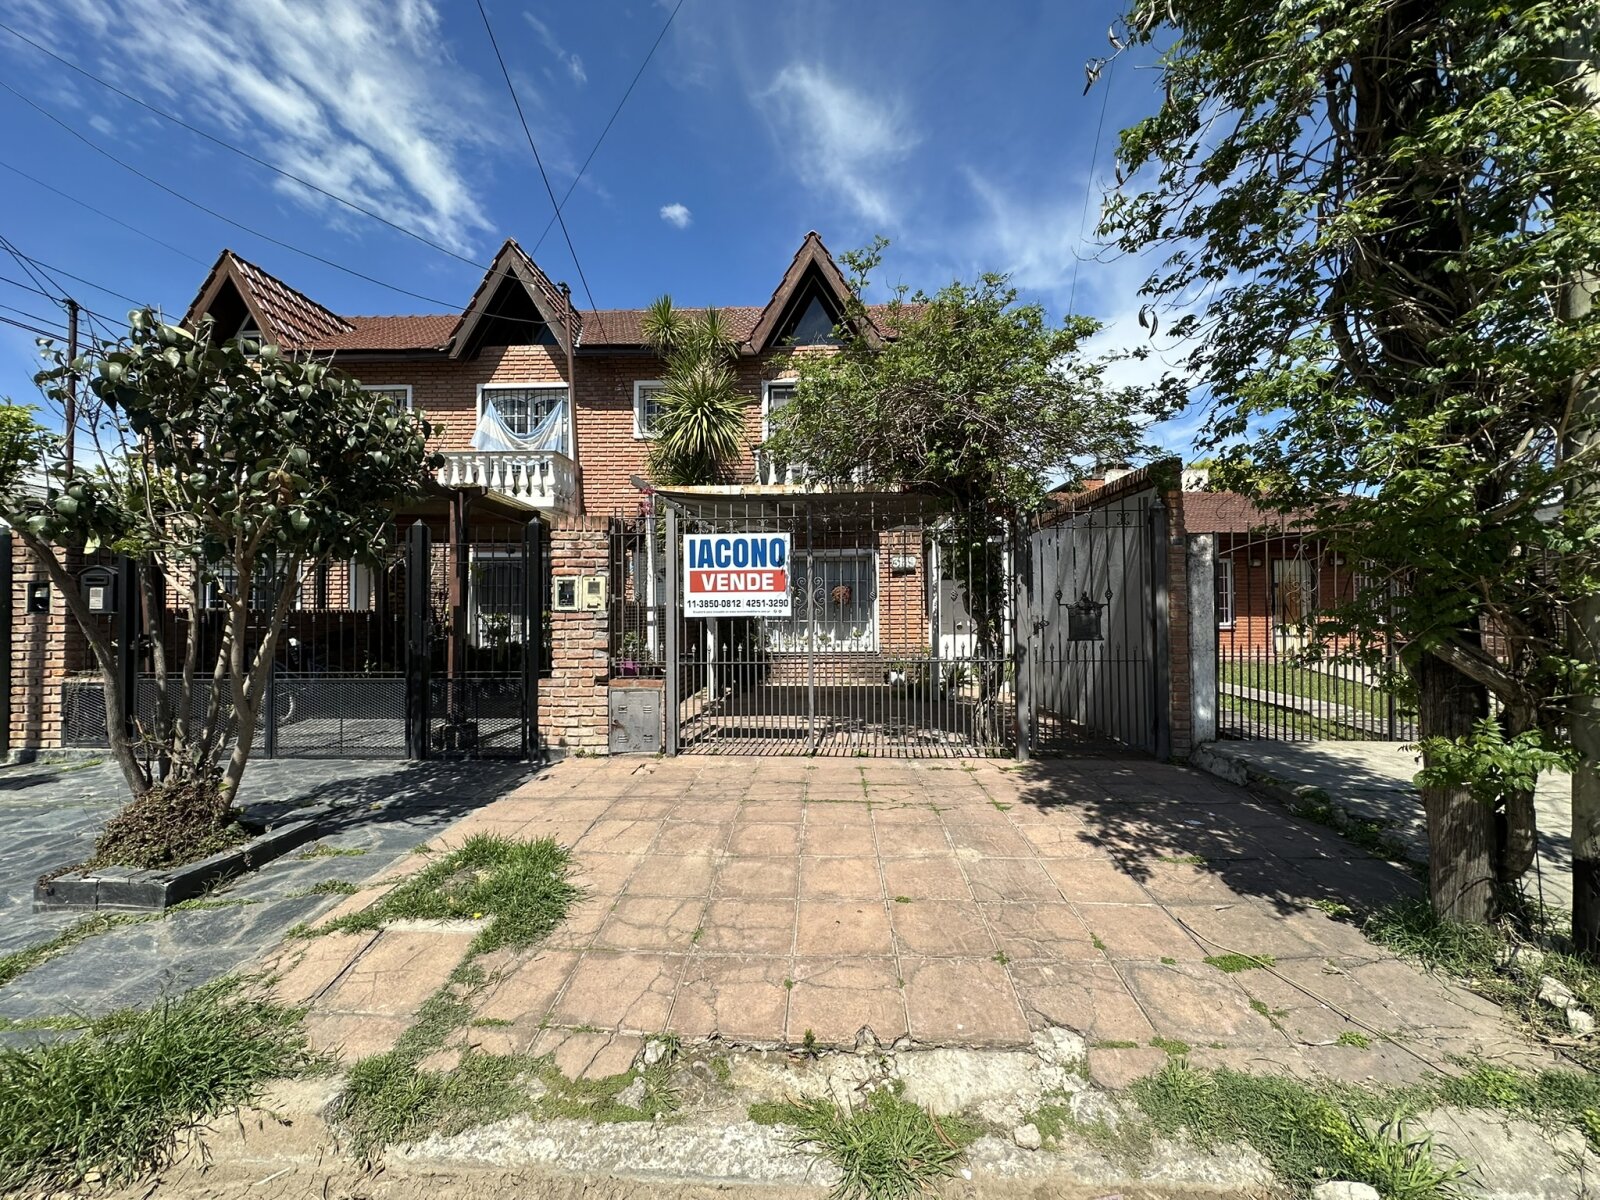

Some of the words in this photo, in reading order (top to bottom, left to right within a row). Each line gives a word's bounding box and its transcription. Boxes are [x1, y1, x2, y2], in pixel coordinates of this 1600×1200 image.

[689, 538, 785, 568] IACONO
[701, 573, 774, 591] VENDE
[687, 599, 741, 608] 11-3850-0812
[746, 599, 789, 607] 4251-3290
